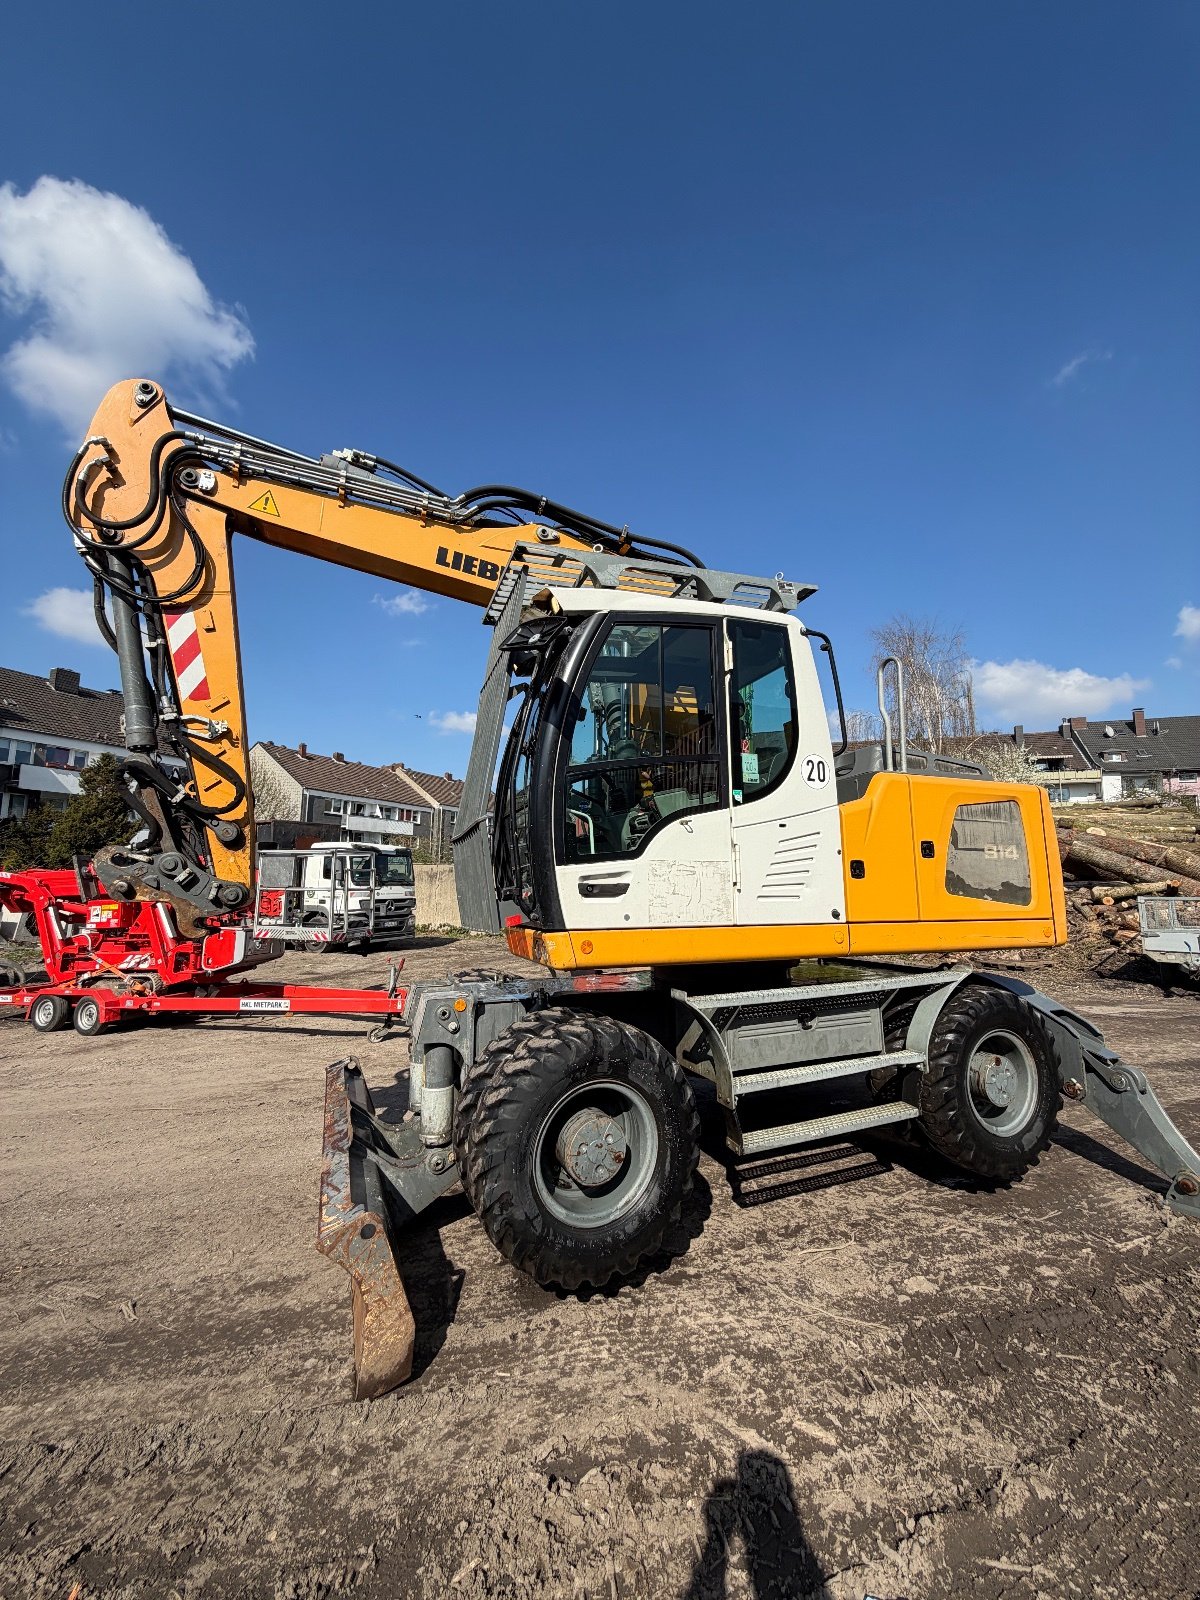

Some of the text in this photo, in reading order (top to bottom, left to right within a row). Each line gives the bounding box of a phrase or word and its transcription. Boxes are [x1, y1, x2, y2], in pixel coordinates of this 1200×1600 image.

[806, 759, 826, 783] 20
[984, 844, 1020, 860] 914
[253, 1001, 283, 1009] MIETPARK
